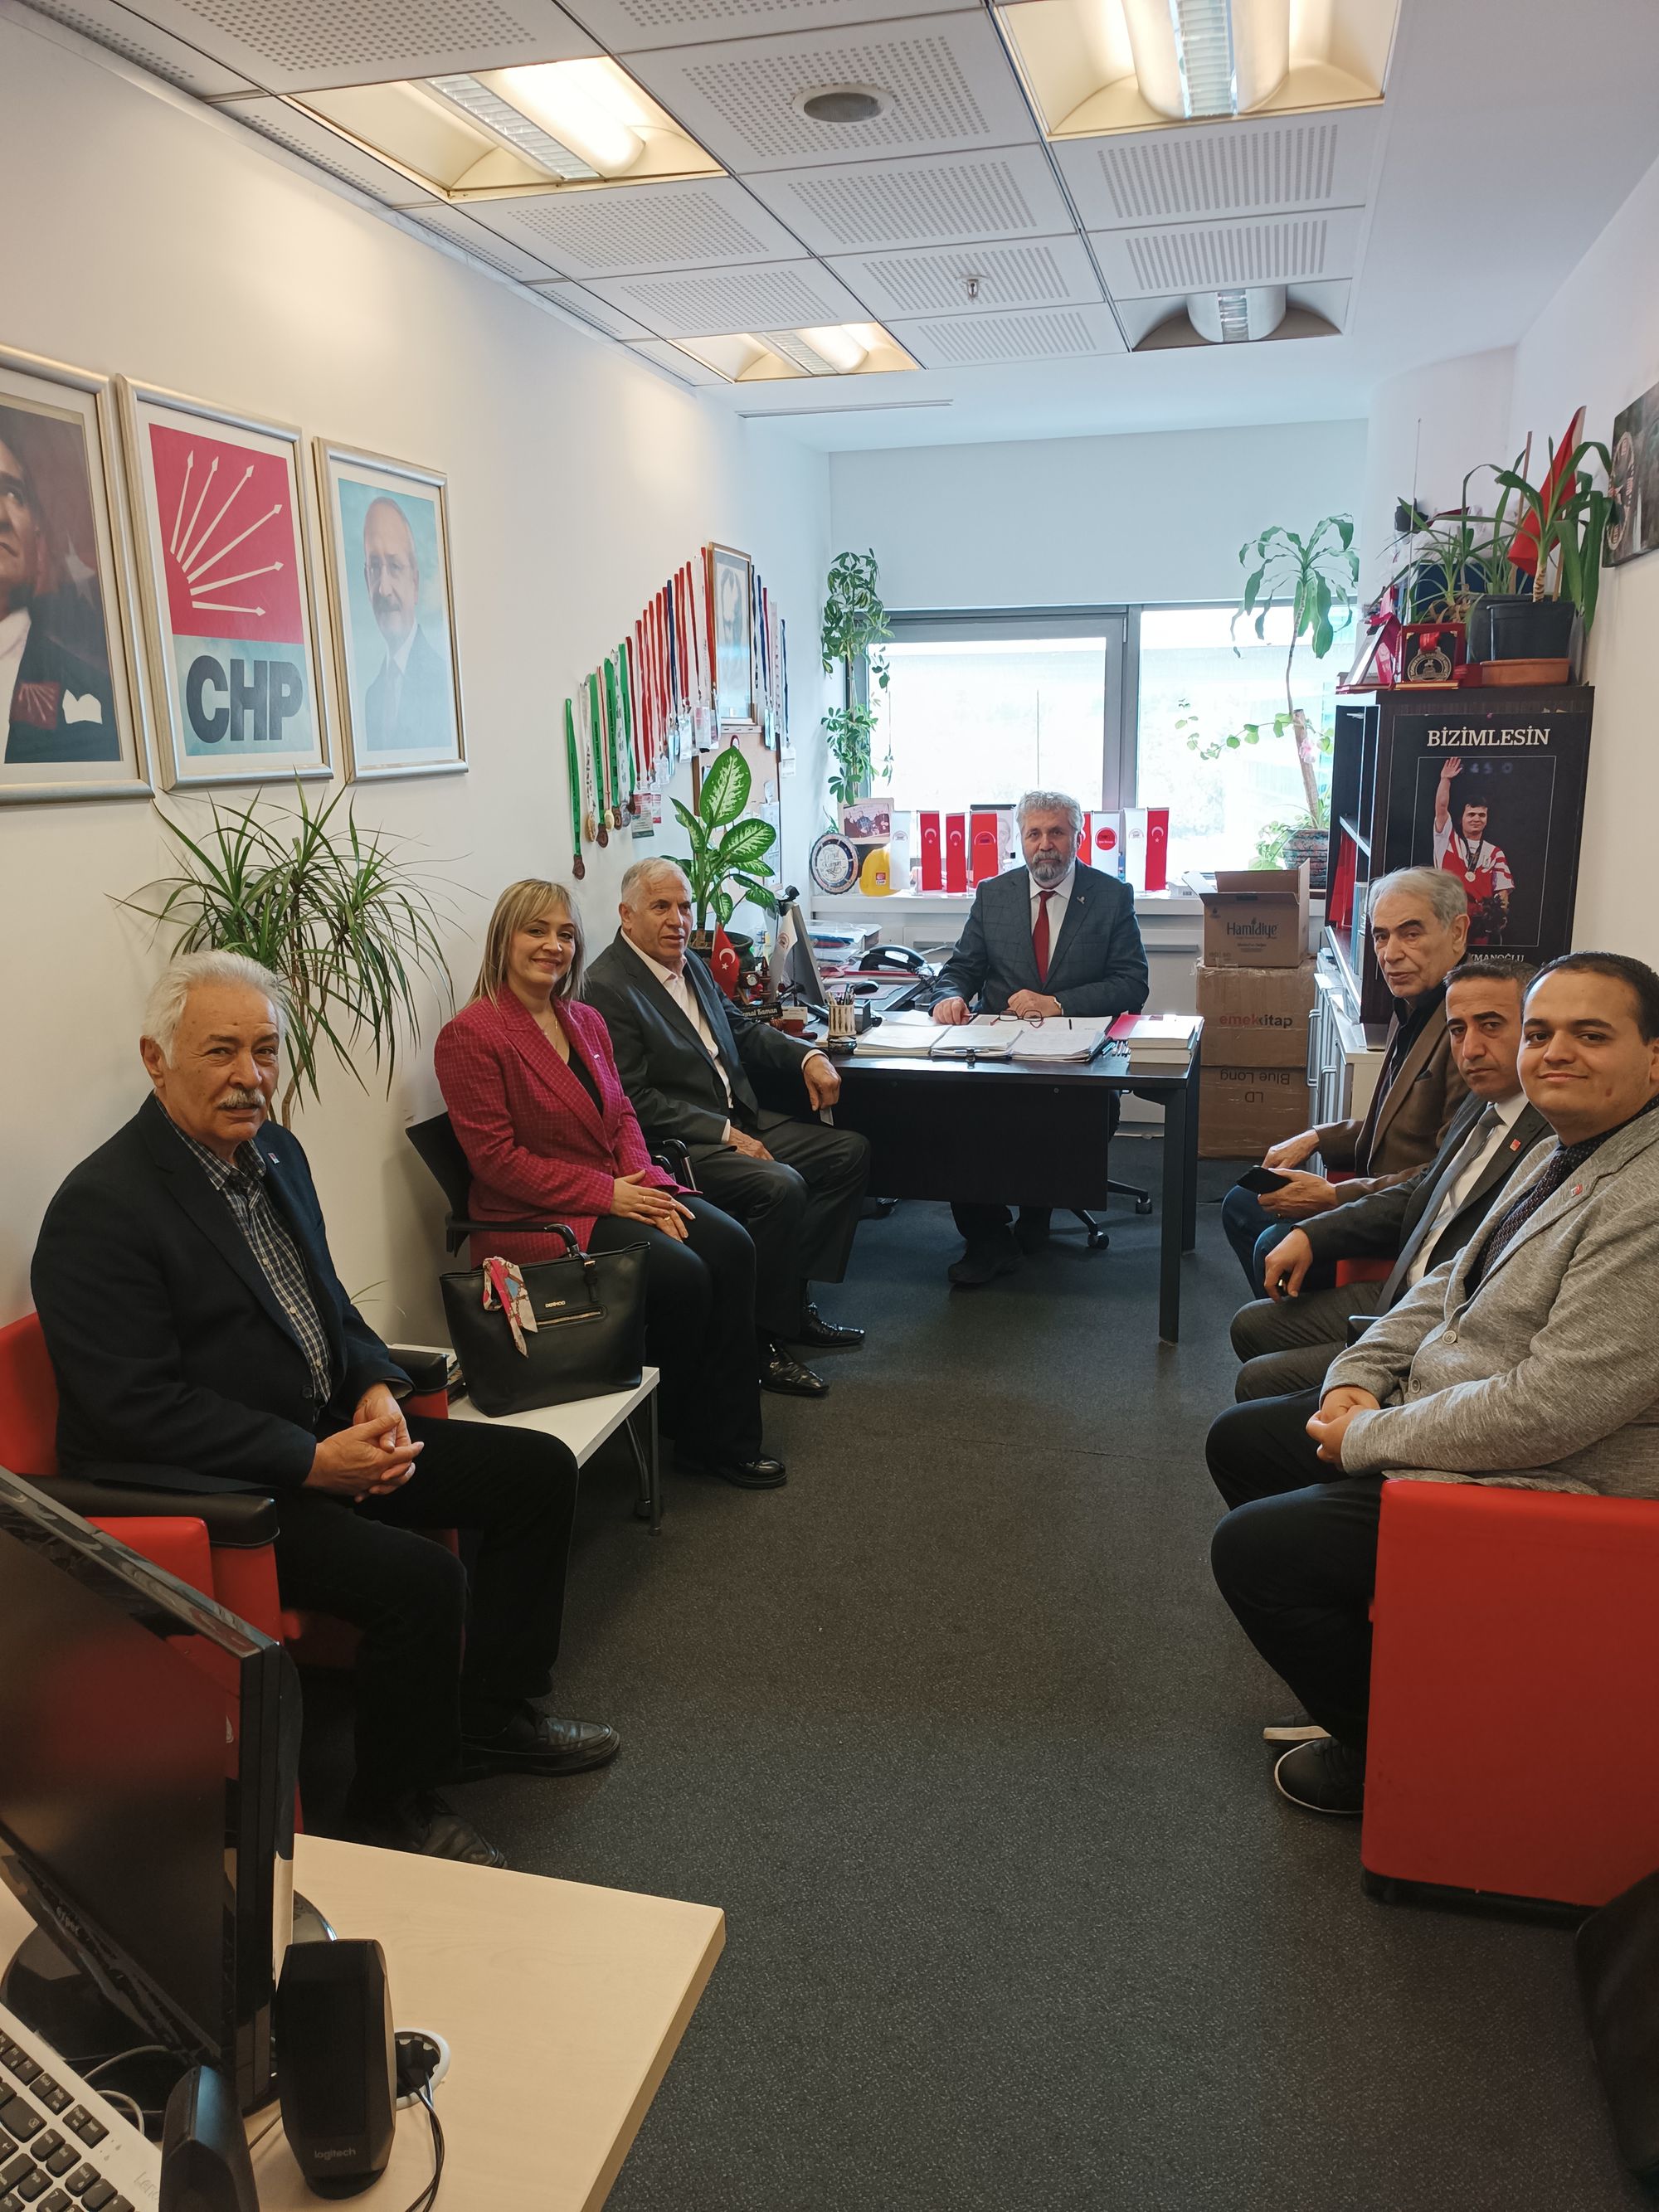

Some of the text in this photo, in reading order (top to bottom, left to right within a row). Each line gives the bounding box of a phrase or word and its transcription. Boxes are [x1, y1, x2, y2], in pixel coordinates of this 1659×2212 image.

[187, 654, 303, 743] CHP
[1427, 725, 1550, 746] BİZİMLESİN
[1227, 918, 1279, 938] Hamidiye
[1220, 1068, 1291, 1085] Blue Long
[1245, 1091, 1264, 1103] LD
[314, 2146, 357, 2161] logitech
